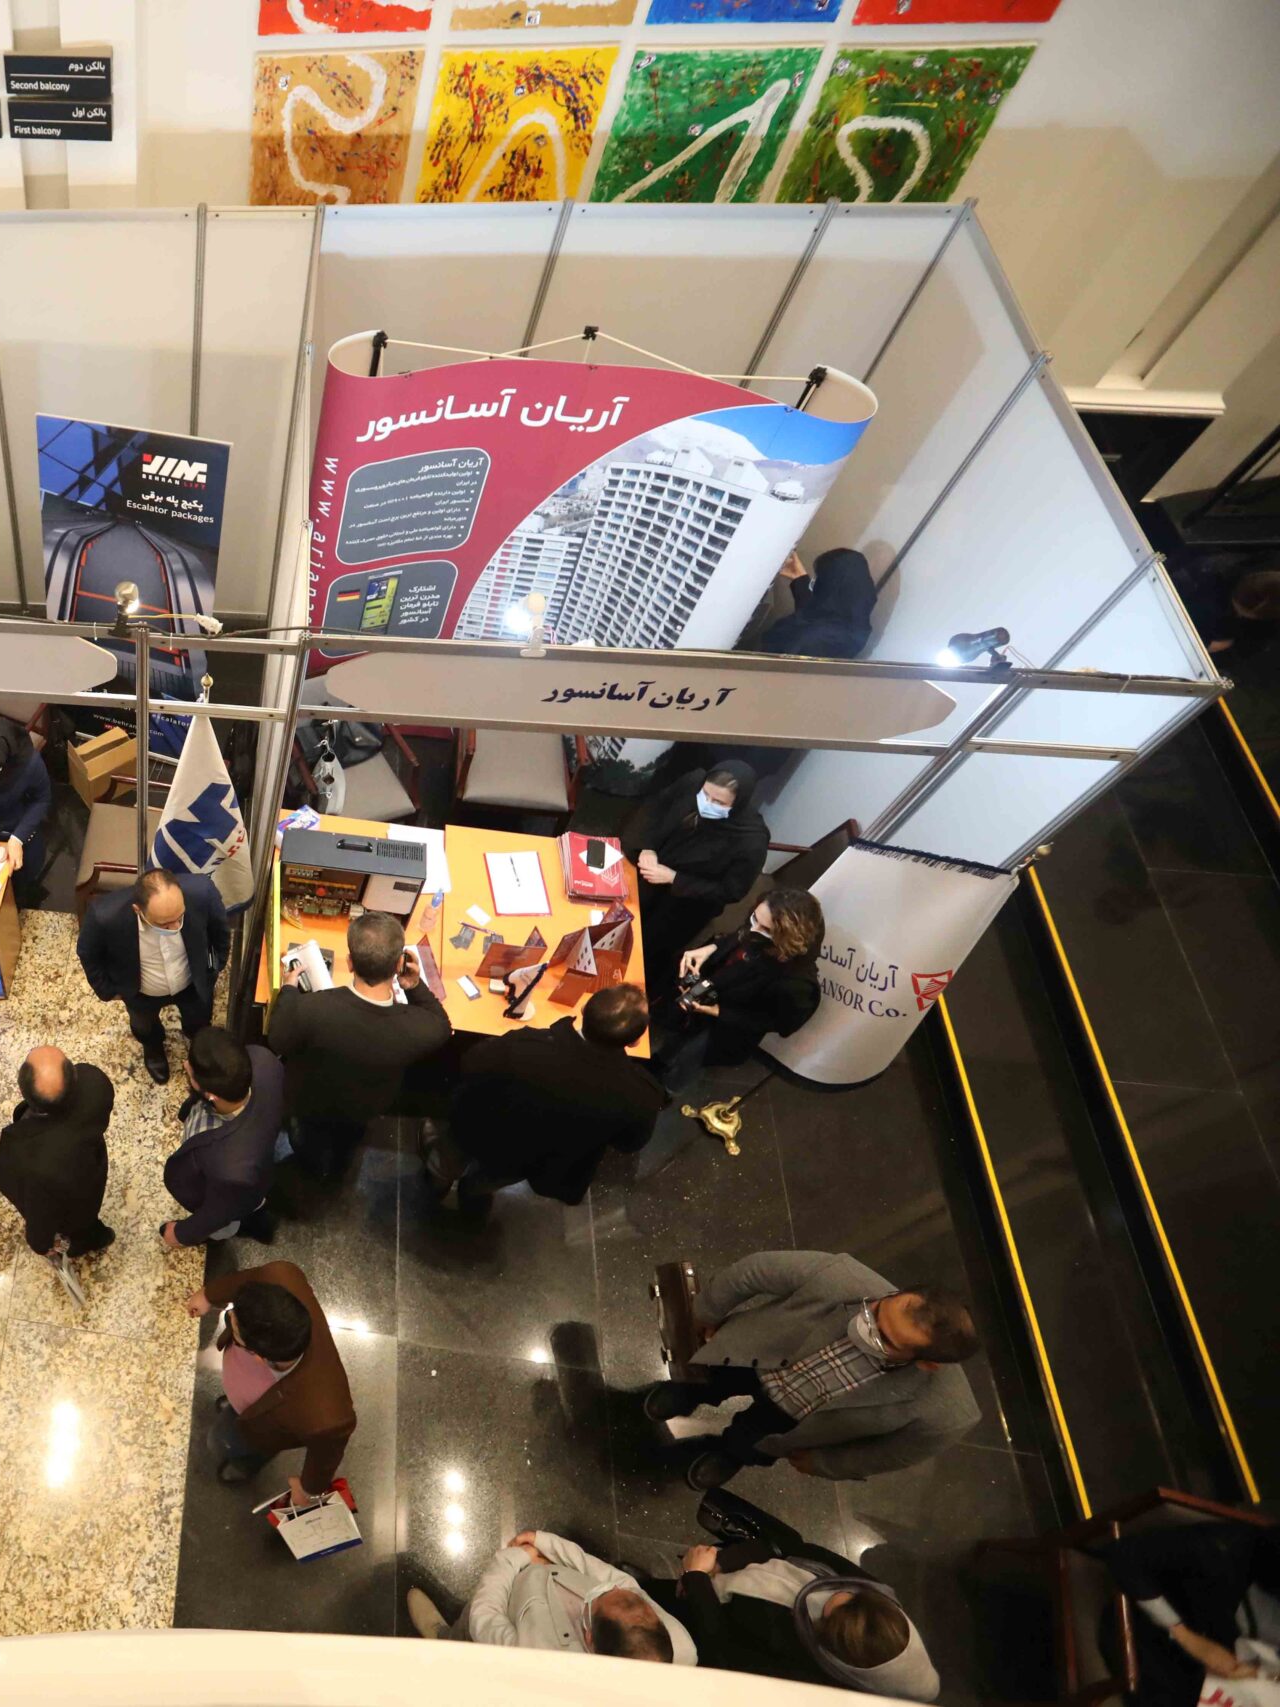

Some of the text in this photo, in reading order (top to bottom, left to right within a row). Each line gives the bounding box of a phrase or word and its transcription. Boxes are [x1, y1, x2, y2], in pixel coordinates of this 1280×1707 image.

[68, 61, 105, 72] بالکن دوم
[10, 80, 70, 92] Second balcony
[72, 108, 106, 119] بالکن اول
[14, 125, 61, 136] First balcony
[356, 388, 630, 442] آریان آسانسور
[418, 457, 484, 473] آریان آسانسور
[142, 473, 180, 485] BEHRAN
[141, 490, 204, 512] پکیج پله برقی
[126, 499, 214, 524] Escalator packages
[400, 607, 432, 618] آسانسور
[540, 681, 737, 711] آریان آسانسور
[820, 945, 899, 991] آریان آسان
